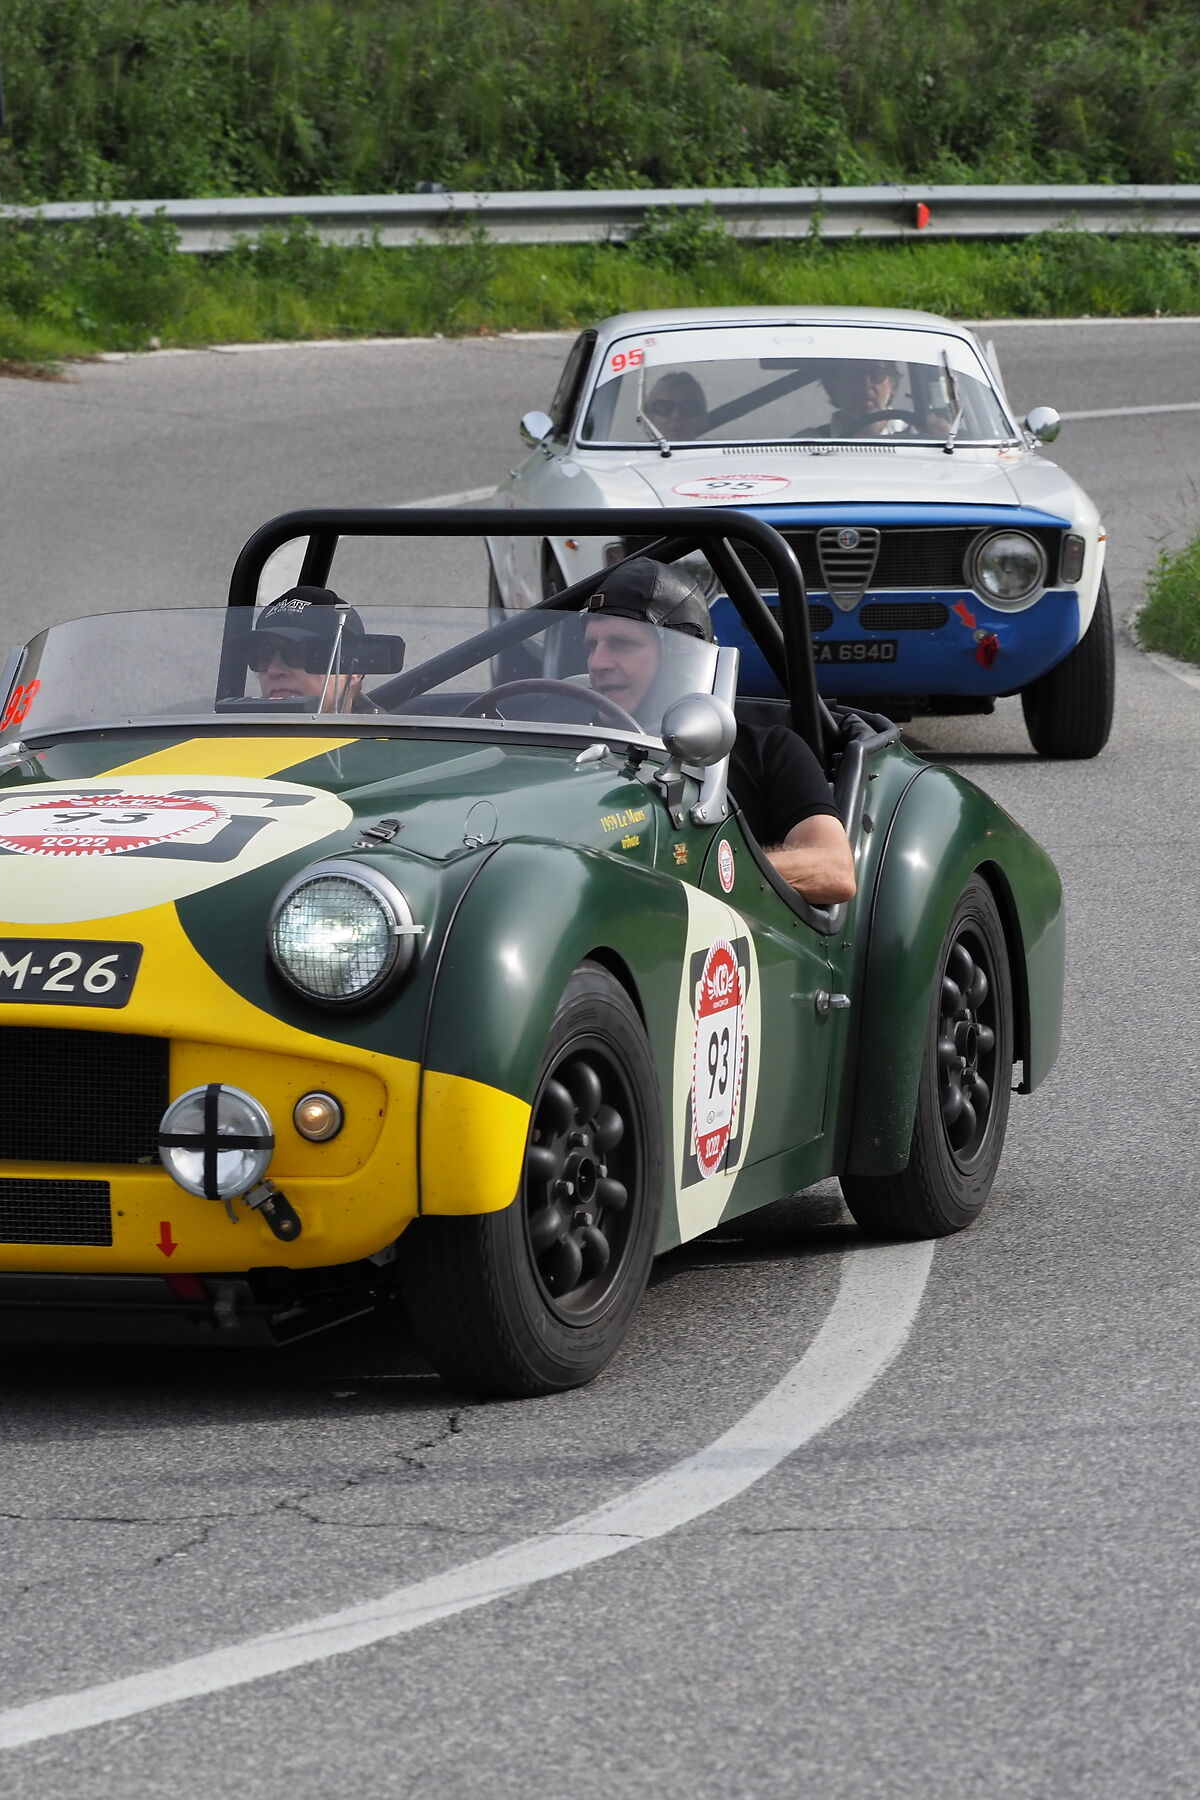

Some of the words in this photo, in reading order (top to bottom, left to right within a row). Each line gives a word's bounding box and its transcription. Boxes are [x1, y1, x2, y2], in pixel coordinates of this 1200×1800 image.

[611, 348, 644, 372] 95
[0, 679, 41, 732] 93
[53, 812, 155, 825] 93
[40, 836, 110, 848] 2022
[708, 1027, 730, 1099] 93
[705, 1134, 720, 1159] 2022
